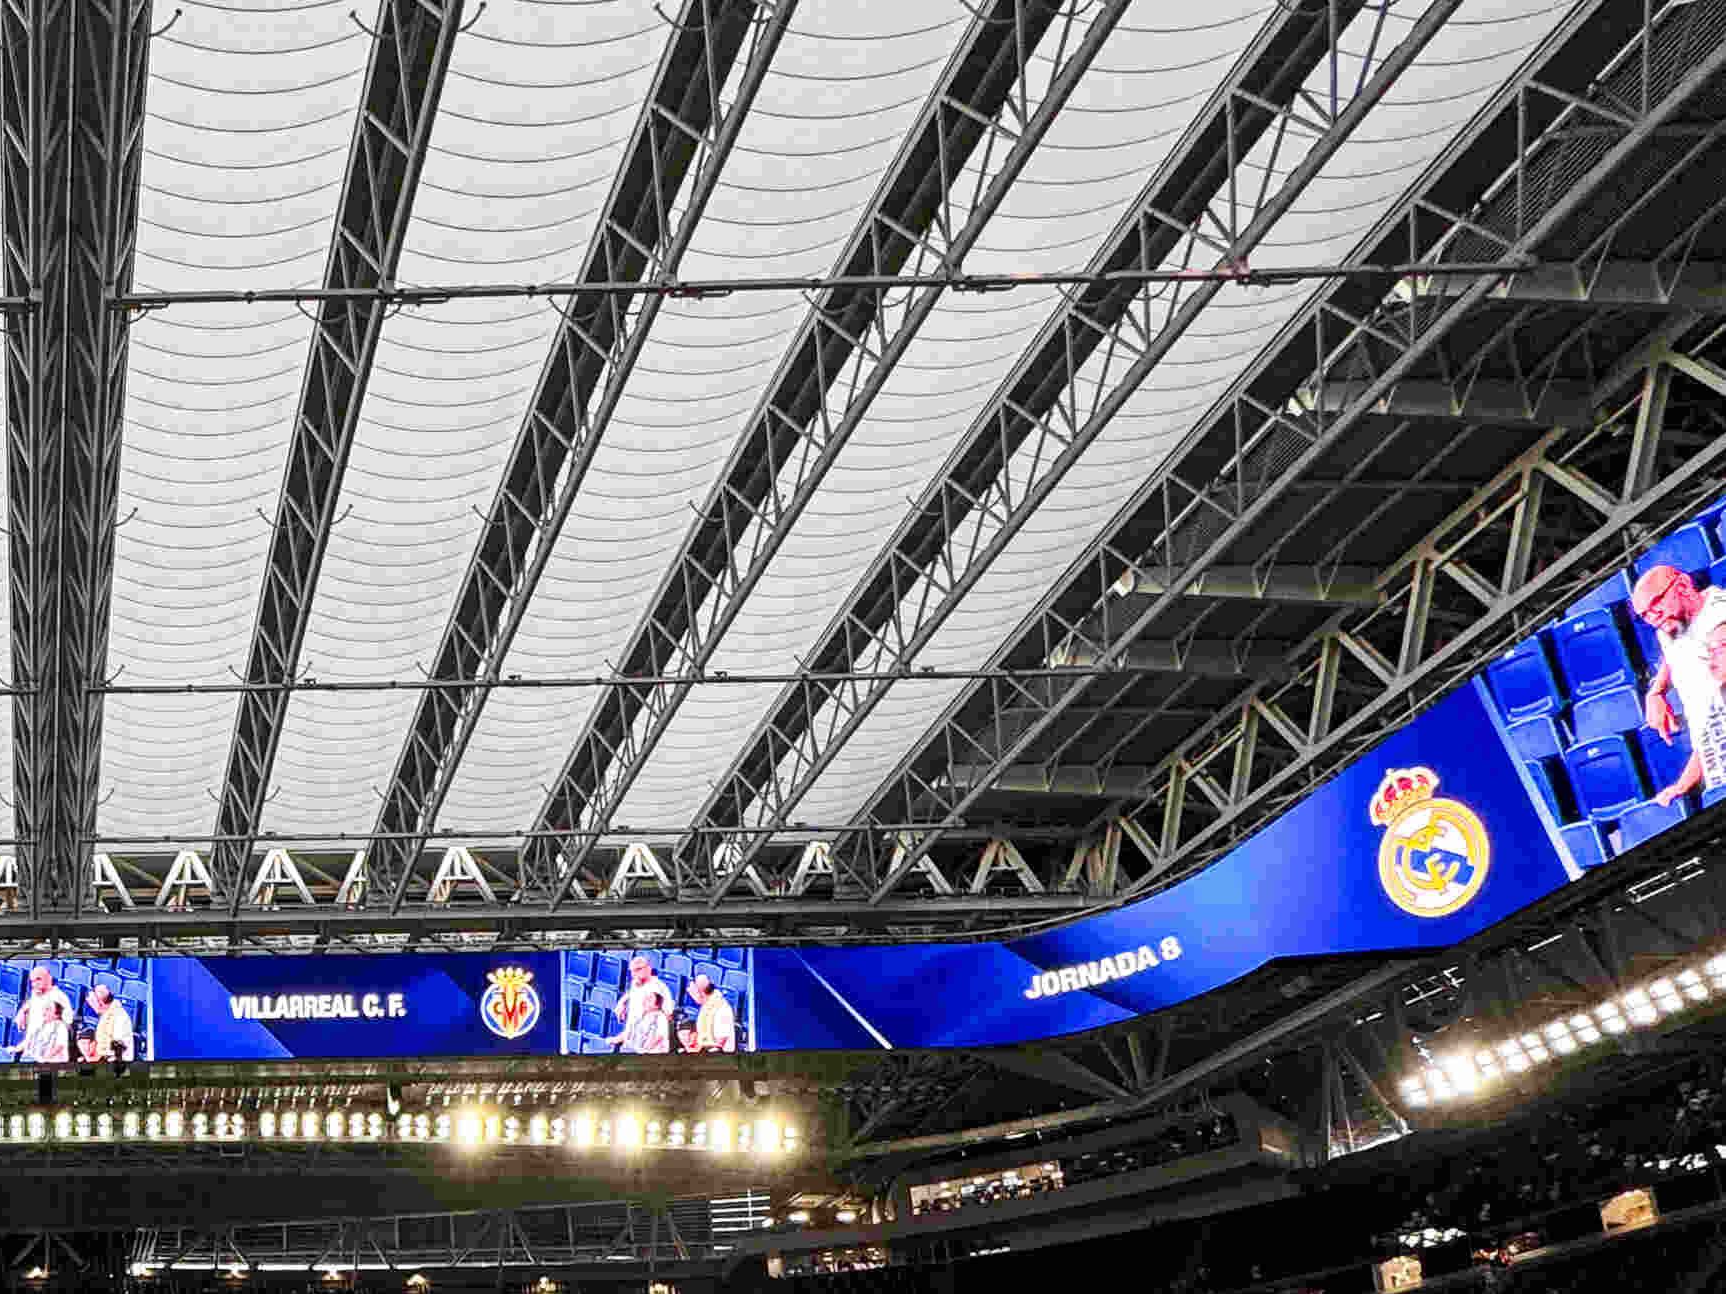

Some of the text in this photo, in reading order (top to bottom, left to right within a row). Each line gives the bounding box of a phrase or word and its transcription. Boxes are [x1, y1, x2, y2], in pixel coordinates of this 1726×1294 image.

[1024, 935, 1182, 999] JORNADA 8
[230, 993, 408, 1019] VILLARREAL C. F.
